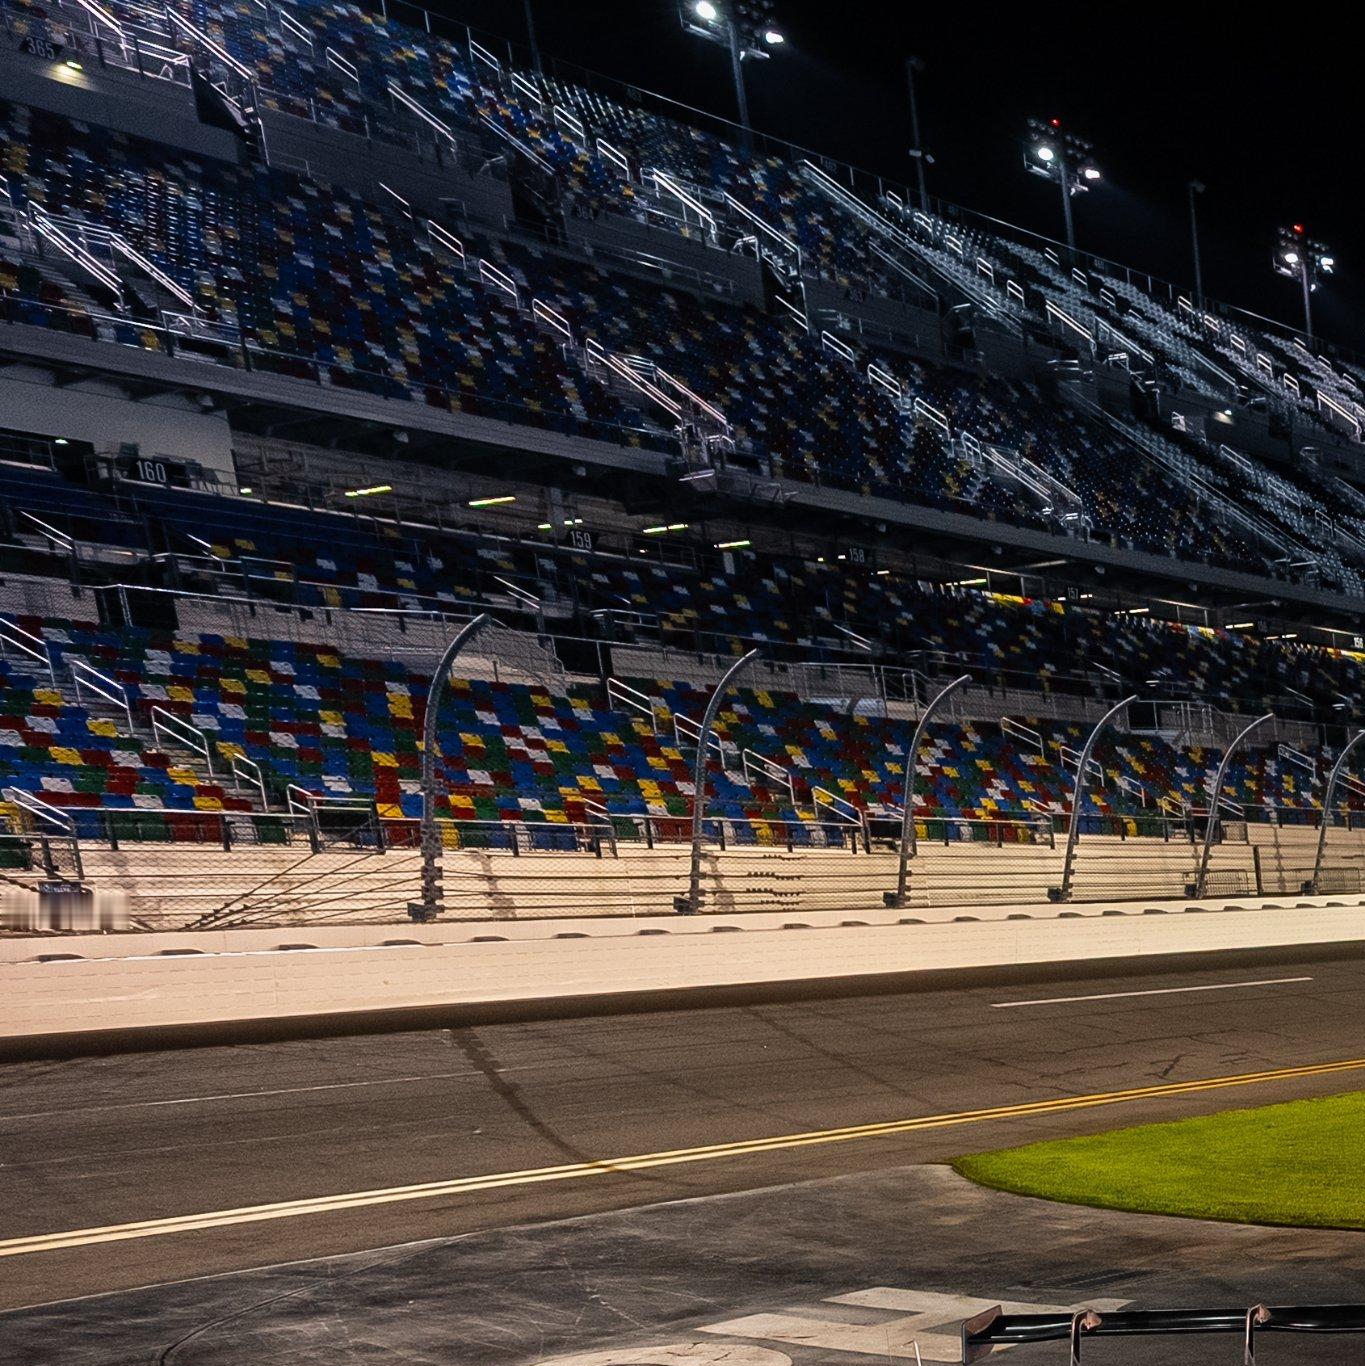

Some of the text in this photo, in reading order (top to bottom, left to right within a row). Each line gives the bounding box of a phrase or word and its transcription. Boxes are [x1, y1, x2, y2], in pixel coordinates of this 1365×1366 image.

[27, 37, 55, 60] 365
[136, 460, 167, 483] 160
[569, 531, 592, 549] 159
